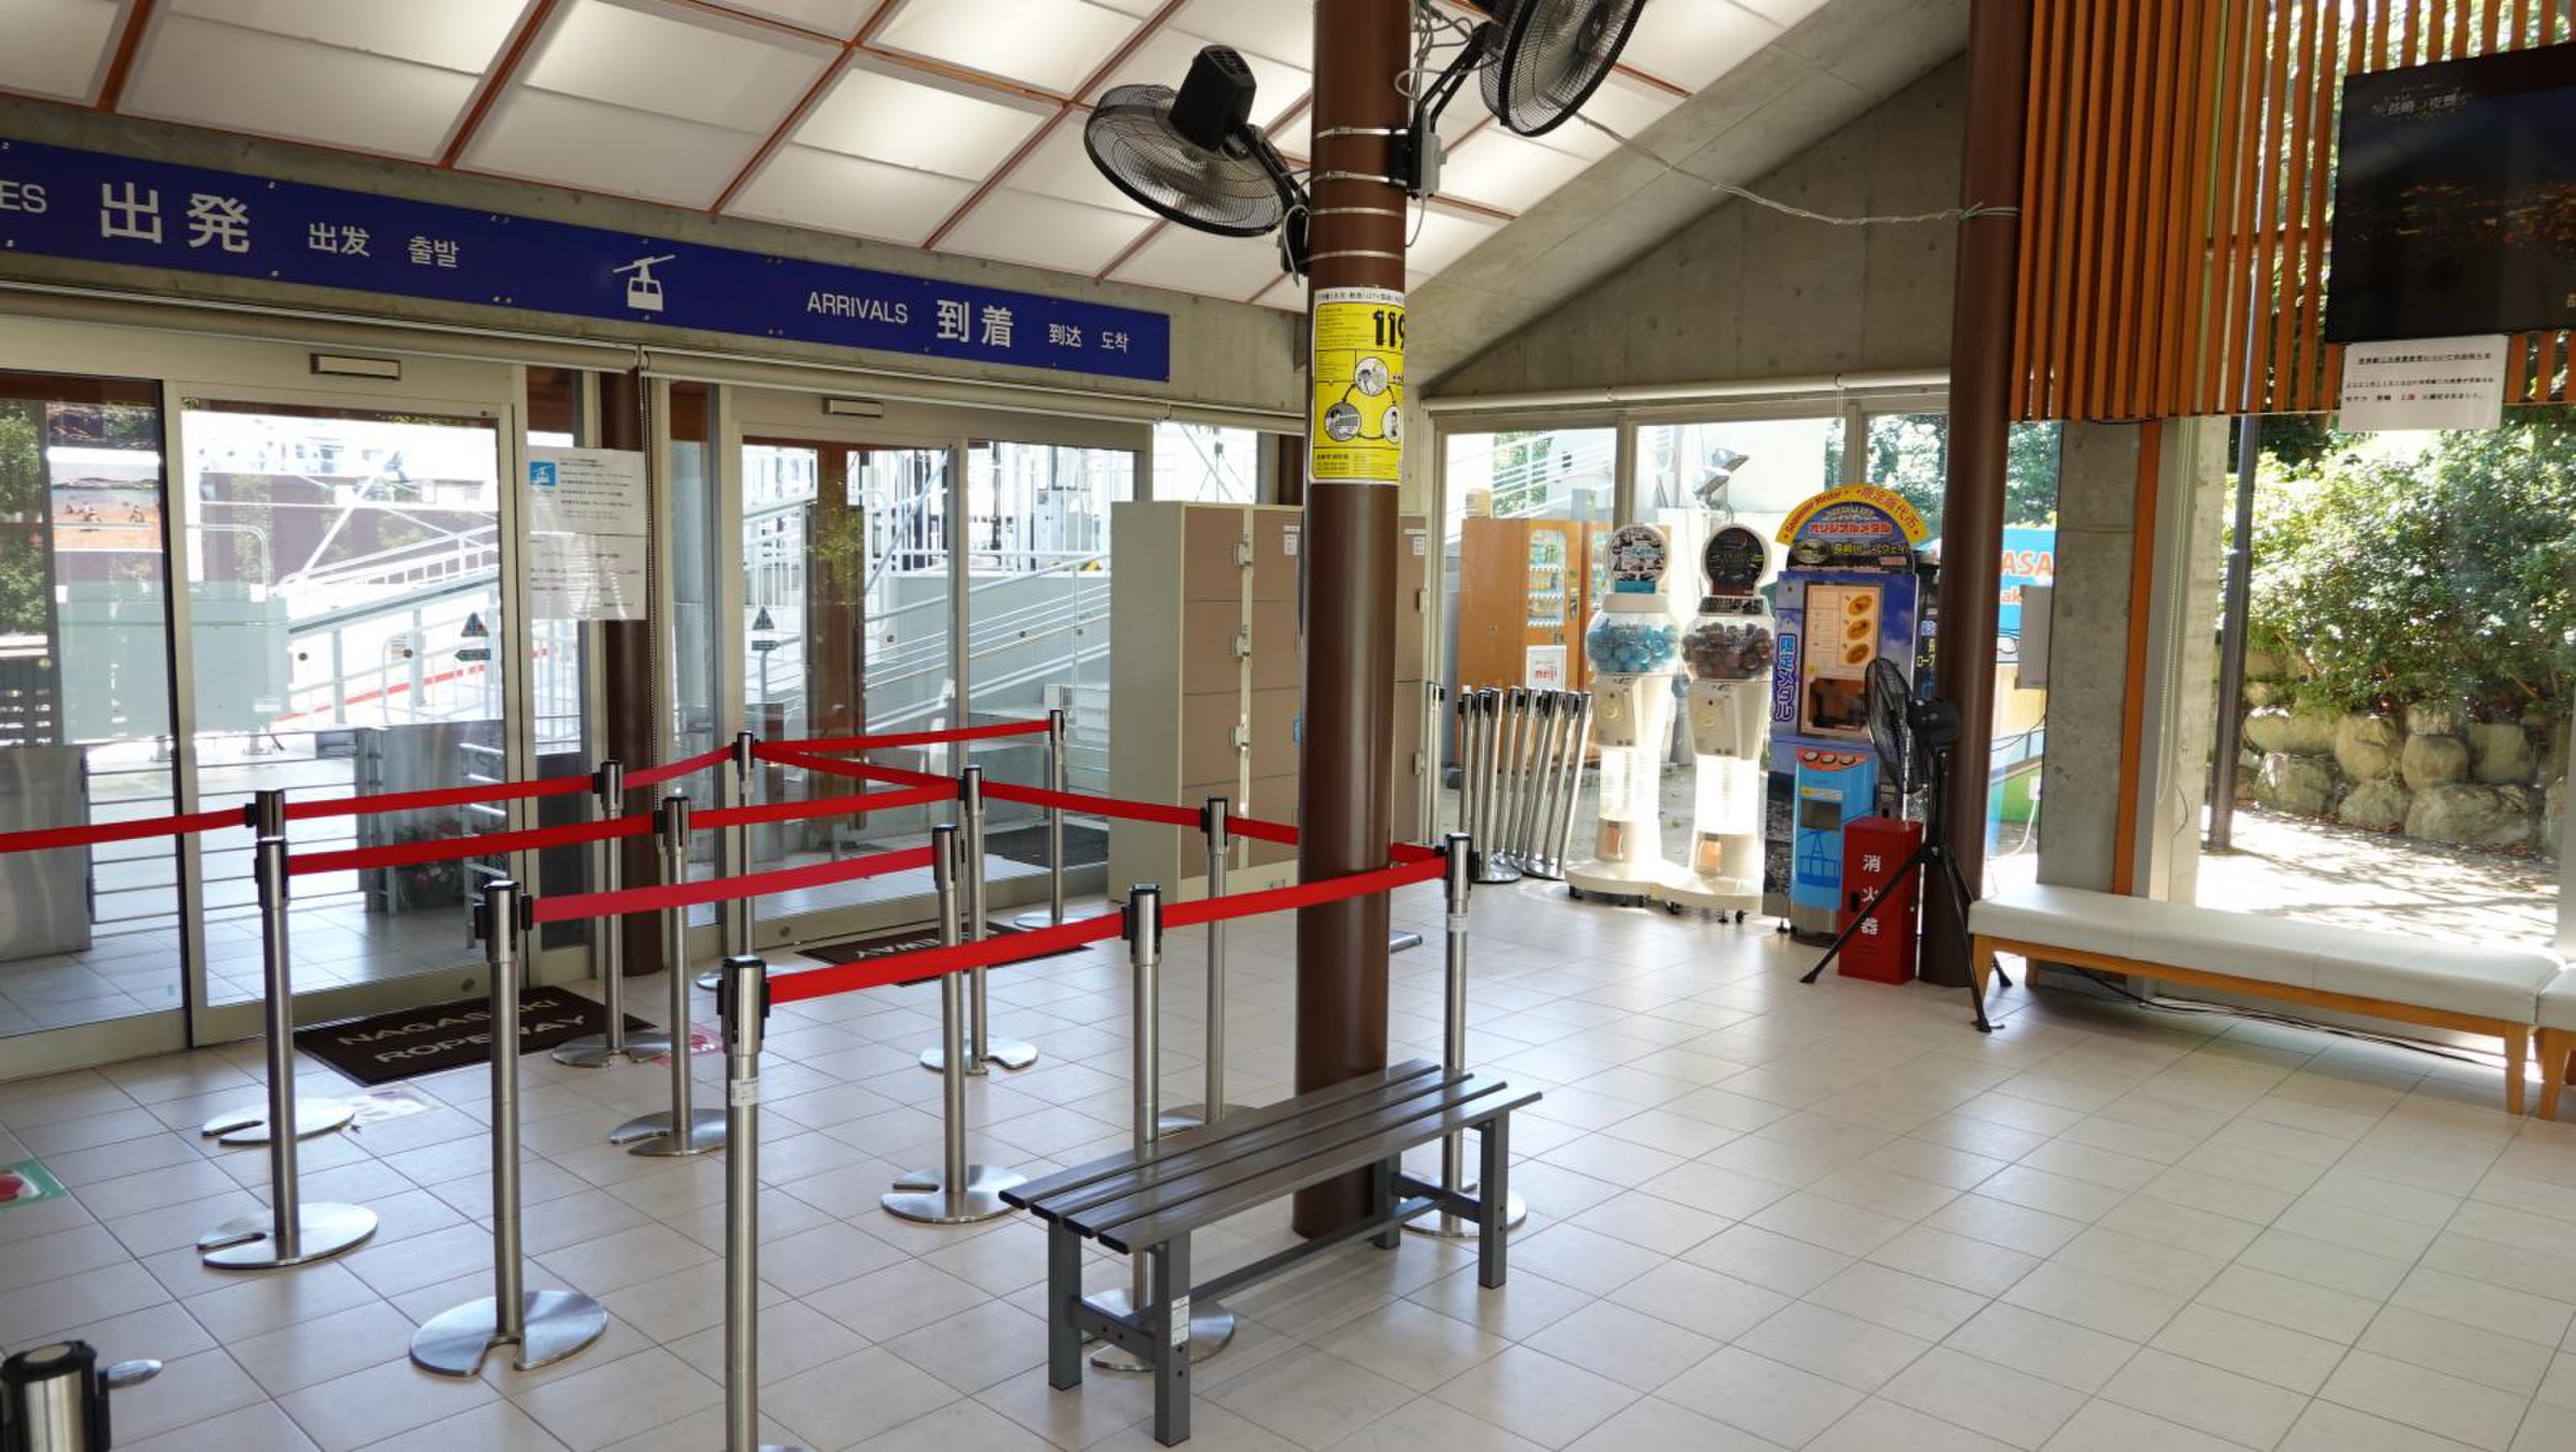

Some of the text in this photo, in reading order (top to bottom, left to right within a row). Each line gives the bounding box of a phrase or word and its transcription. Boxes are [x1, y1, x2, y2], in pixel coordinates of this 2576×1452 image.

[407, 236, 460, 269] 출발
[807, 290, 908, 324] ARRIVALS
[935, 298, 1014, 348] 到着
[1100, 330, 1129, 353] 도착
[1861, 854, 1882, 935] 消火器
[337, 999, 560, 1045] NAGASKI
[374, 1014, 585, 1063] ROPEAY
